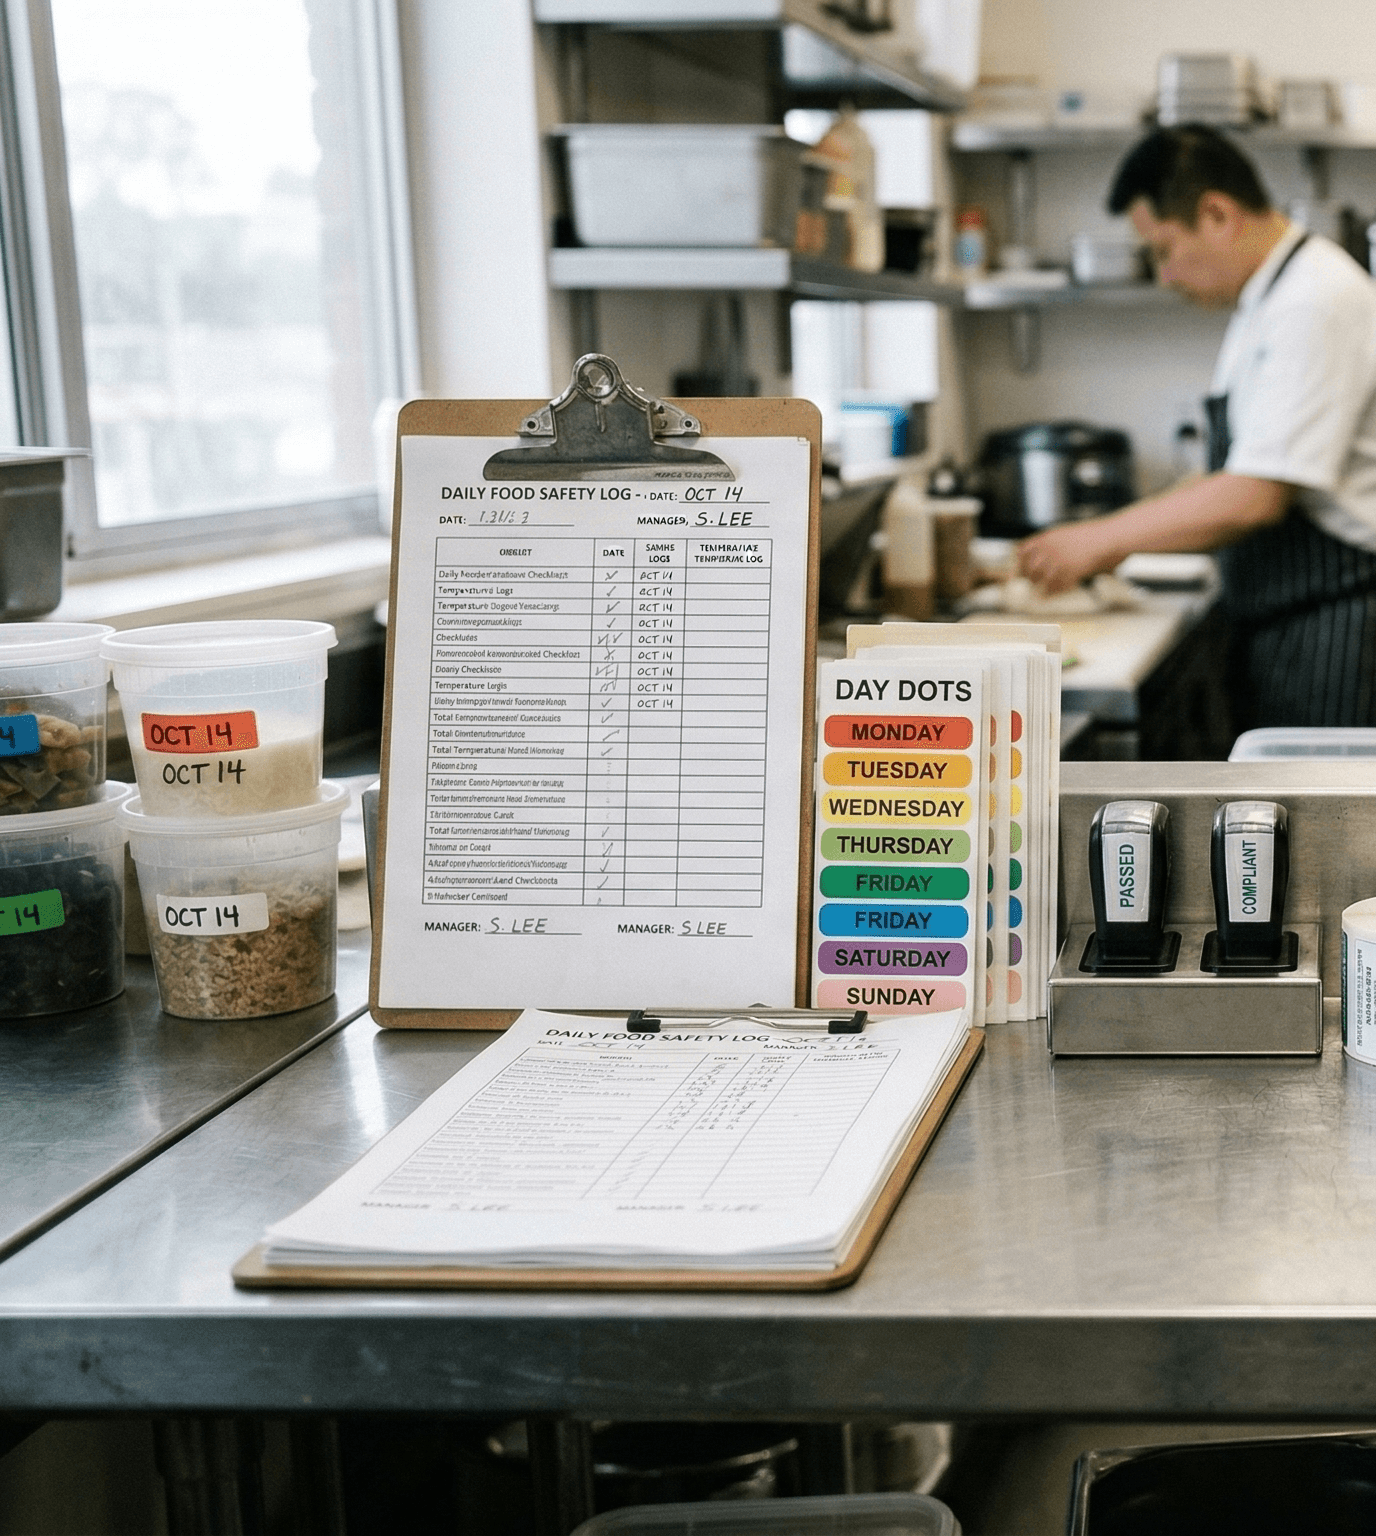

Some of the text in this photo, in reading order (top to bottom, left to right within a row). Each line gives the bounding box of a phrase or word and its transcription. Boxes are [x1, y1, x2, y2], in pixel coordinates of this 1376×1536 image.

[441, 486, 486, 500] DAILY
[490, 487, 535, 500] FOOD
[539, 487, 596, 500] SAFETY
[600, 487, 632, 501] LOG
[684, 486, 717, 502] OCT
[724, 486, 744, 502] 14
[718, 511, 753, 527] LEE
[602, 549, 625, 557] DATE
[638, 635, 660, 644] OCT
[638, 651, 660, 660] OCT
[637, 667, 659, 676] OCT
[637, 683, 659, 692] OCT
[835, 678, 973, 702] DAY DOTS
[637, 699, 659, 708] OCT
[150, 723, 233, 746] OCT 14
[851, 722, 946, 742] MONDAY
[162, 759, 247, 785] OCT 14
[847, 760, 948, 780] TUESDAY
[828, 798, 965, 818] WEDNESDAY
[836, 835, 954, 855] THURSDAY
[855, 873, 933, 892] FRIDAY
[1119, 843, 1135, 908] PASSED
[1241, 839, 1257, 915] COMPLIANT
[14, 903, 40, 927] 14
[165, 904, 240, 928] OCT 14
[854, 911, 933, 930] FRIDAY
[424, 921, 481, 932] MANAGER:
[511, 917, 548, 933] LEE
[617, 921, 728, 936] MANAGER: S LEE
[834, 948, 951, 968] SATURDAY
[846, 987, 936, 1006] SUNDAY
[545, 1028, 600, 1039] DAILY
[602, 1032, 656, 1041] FOOD
[732, 1034, 771, 1043] LOG
